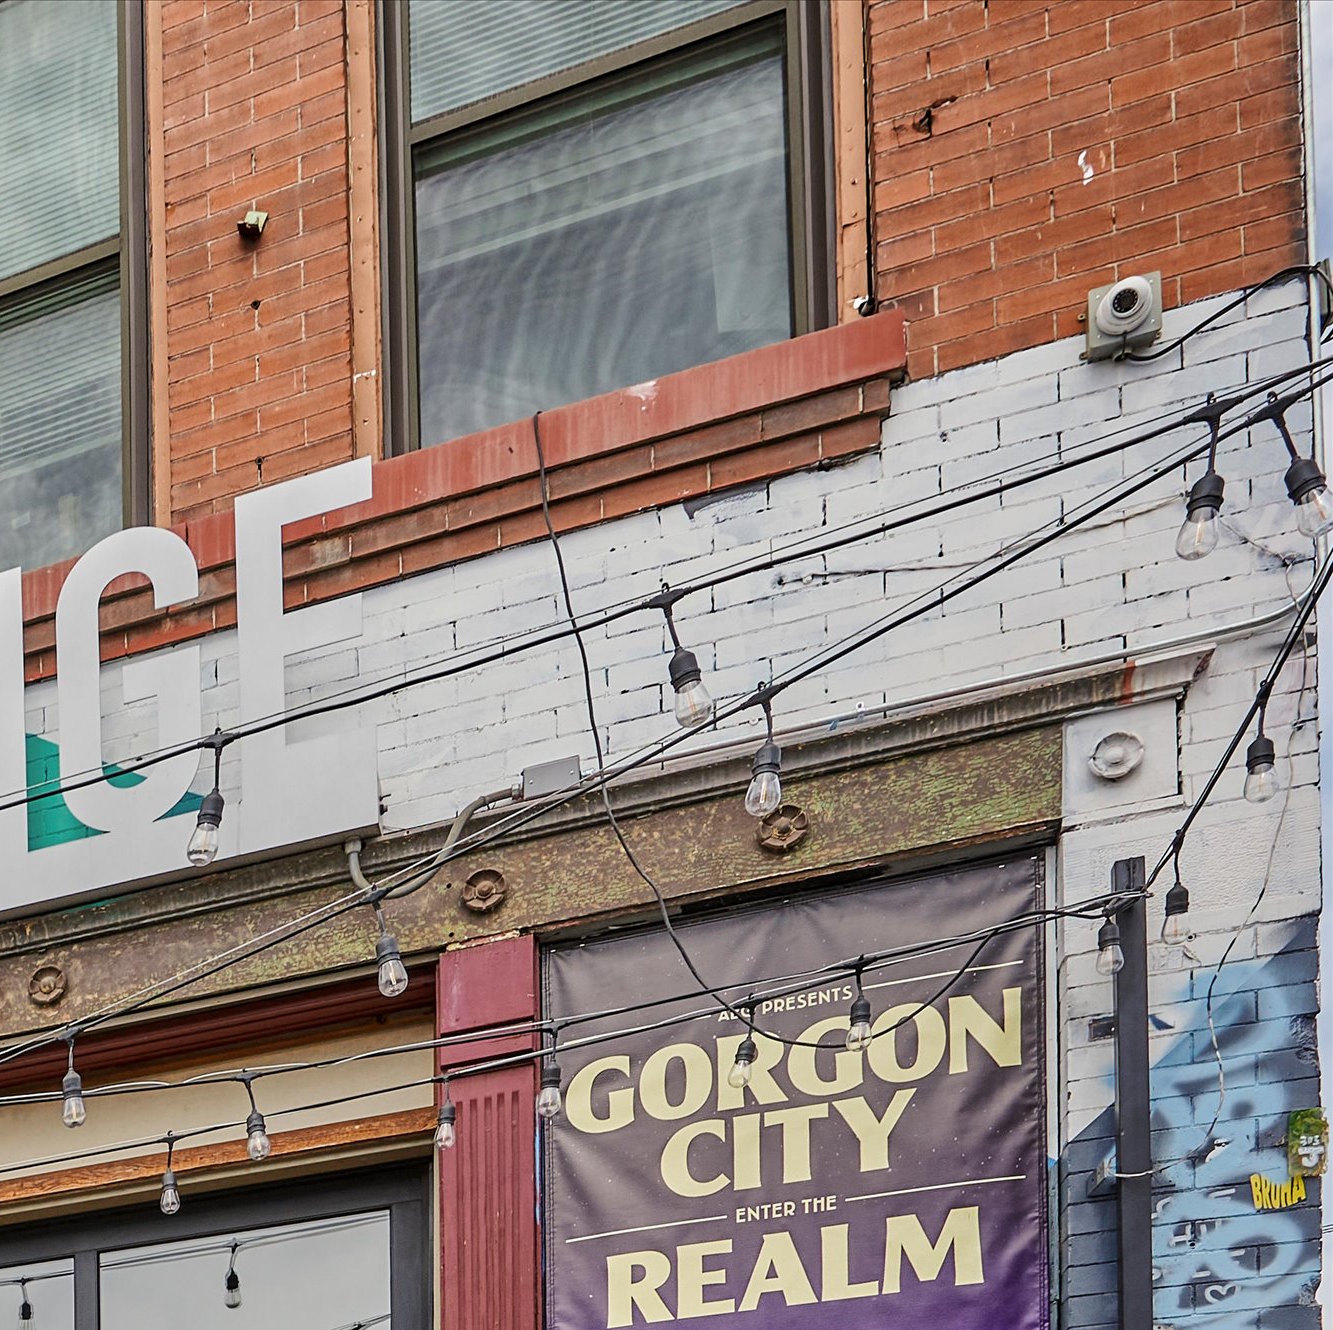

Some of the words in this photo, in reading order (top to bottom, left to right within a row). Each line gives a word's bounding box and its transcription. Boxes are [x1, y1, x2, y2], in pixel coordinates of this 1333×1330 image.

[762, 985, 853, 1015] PRESENTS
[565, 987, 1023, 1134] GORGON
[661, 1089, 915, 1198] CITY
[735, 1200, 796, 1224] ENTER
[802, 1193, 838, 1216] THE
[605, 1206, 984, 1330] REALM
